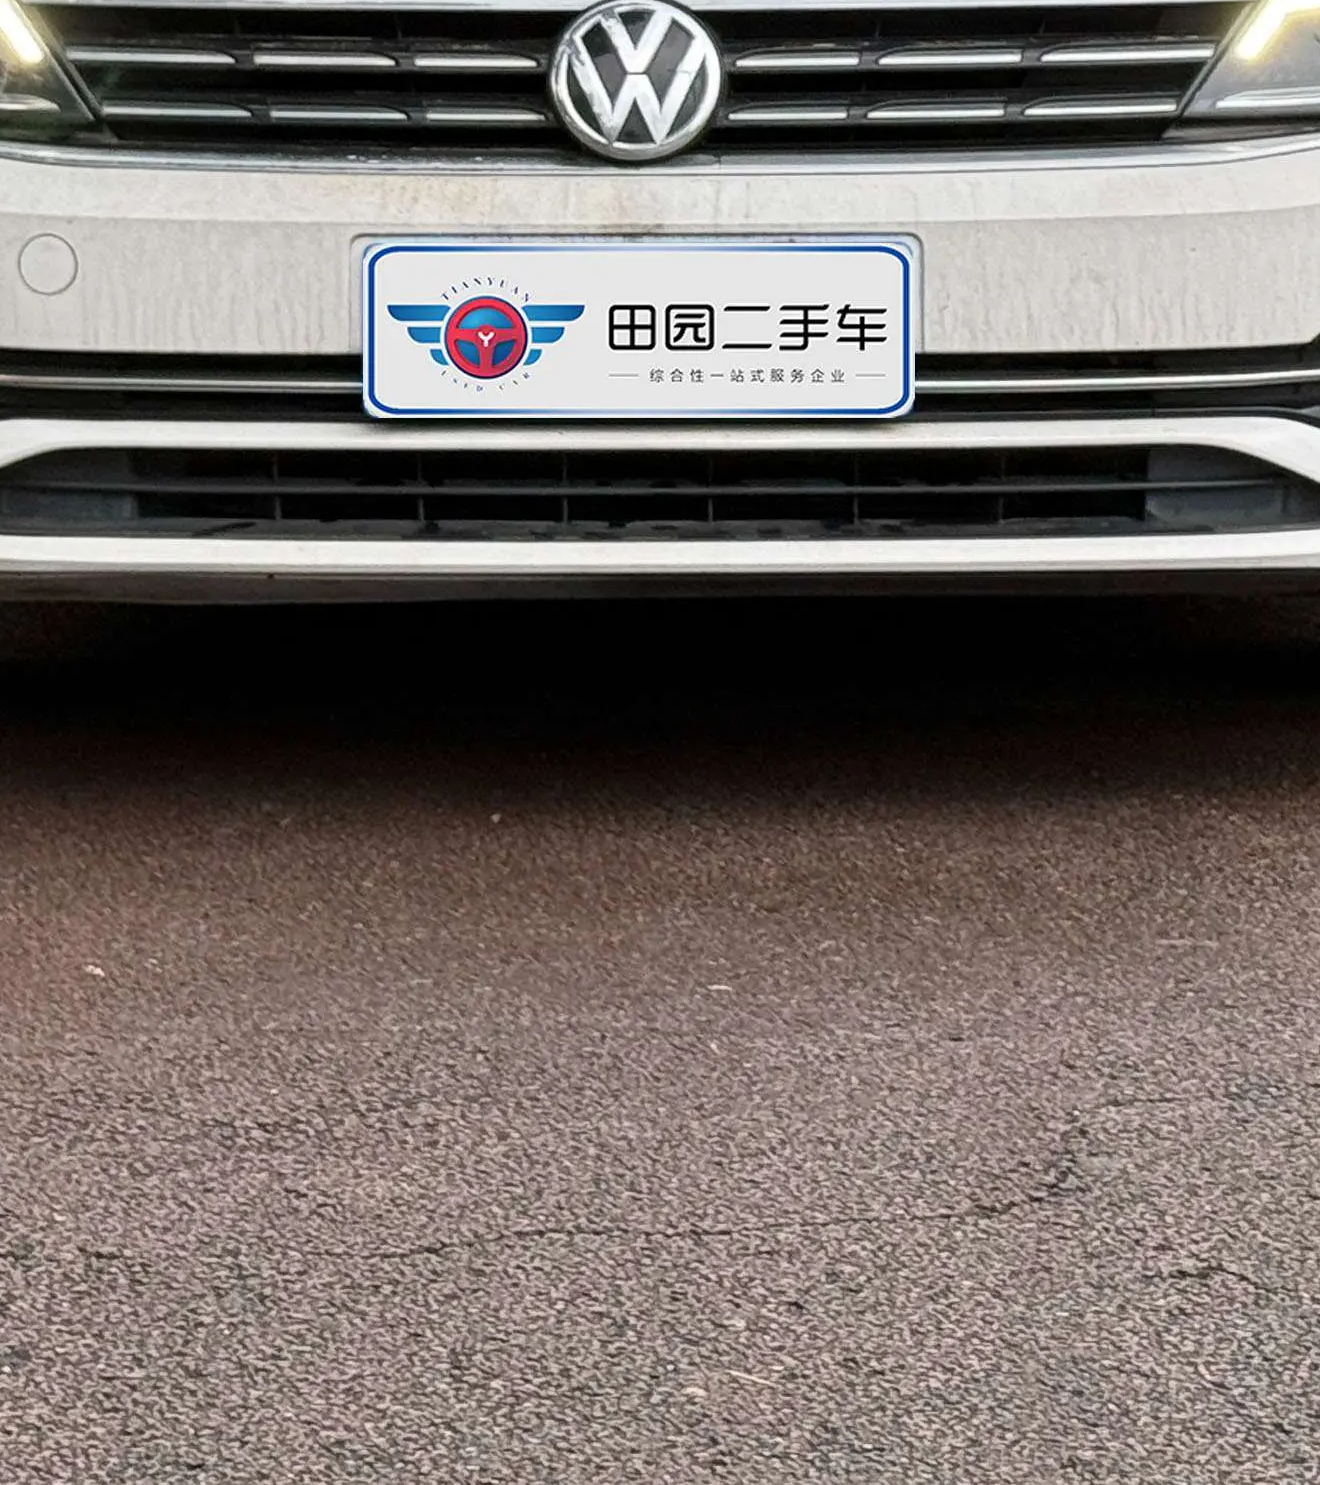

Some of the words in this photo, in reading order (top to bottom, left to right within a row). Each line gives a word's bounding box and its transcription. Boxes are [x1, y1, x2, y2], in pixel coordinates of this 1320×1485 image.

[608, 304, 888, 351] 田园二手车
[649, 368, 845, 384] 综合性一站式服务企业
